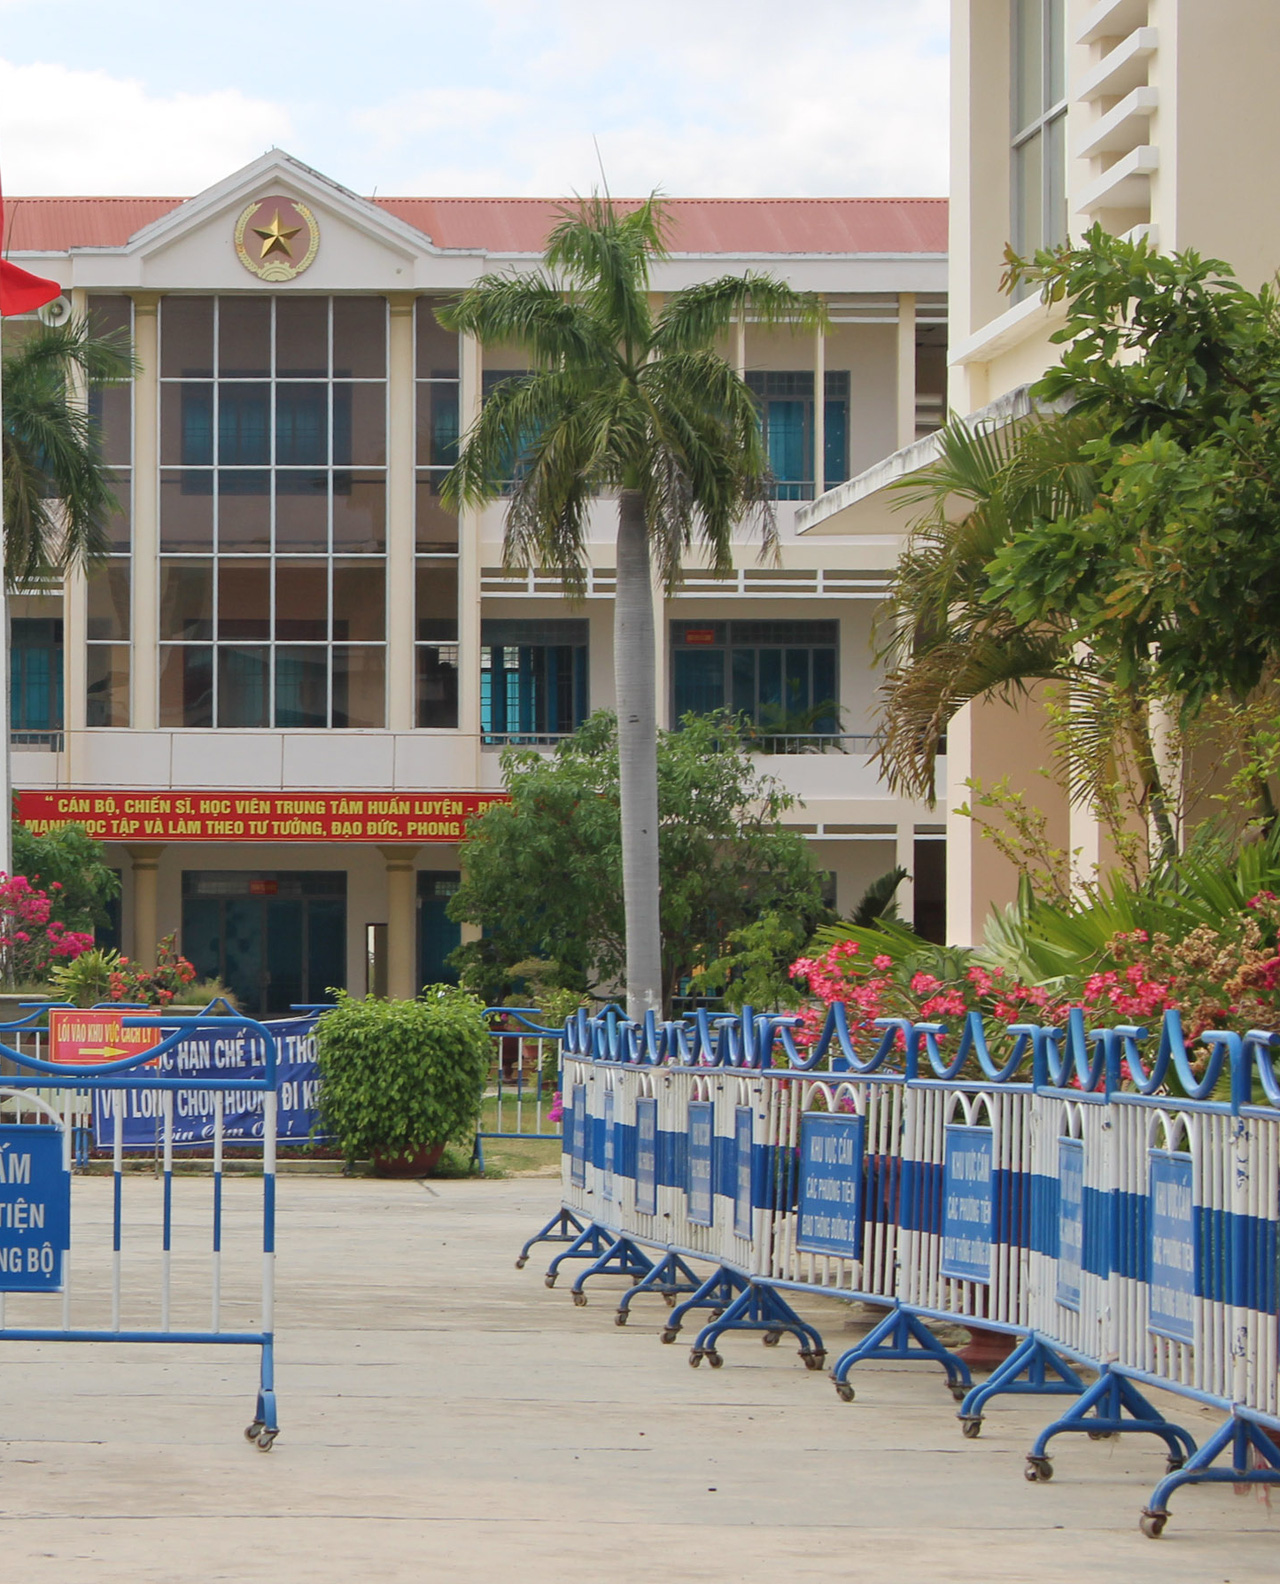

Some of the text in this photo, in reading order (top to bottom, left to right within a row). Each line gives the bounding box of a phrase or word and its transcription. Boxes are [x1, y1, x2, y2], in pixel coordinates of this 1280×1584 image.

[58, 796, 90, 813] CÁN
[94, 797, 119, 816] BỘ,
[124, 796, 171, 813] CHIẾN
[175, 798, 195, 815] SĨ,
[200, 800, 231, 817] HỌC
[235, 798, 270, 814] VIÊN
[275, 801, 326, 814] TRUNG
[330, 798, 363, 814] TÂM
[368, 796, 410, 814] HUẤN
[415, 799, 463, 818] LUYỆN
[111, 817, 140, 836] TẬP
[144, 818, 164, 834] VÀ
[168, 818, 201, 834] LÀM
[205, 821, 244, 834] THEO
[248, 820, 269, 834] TƯ
[271, 817, 327, 836] TƯỞNG,
[331, 821, 363, 838] ĐẠO
[367, 819, 402, 837] ĐỨC,
[407, 822, 460, 835] PHONG
[71, 1018, 86, 1042] VÀO
[88, 1023, 103, 1042] KHU
[215, 1028, 246, 1068] CHẾ
[282, 1081, 298, 1110] ĐI
[27, 1241, 54, 1278] BỘ
